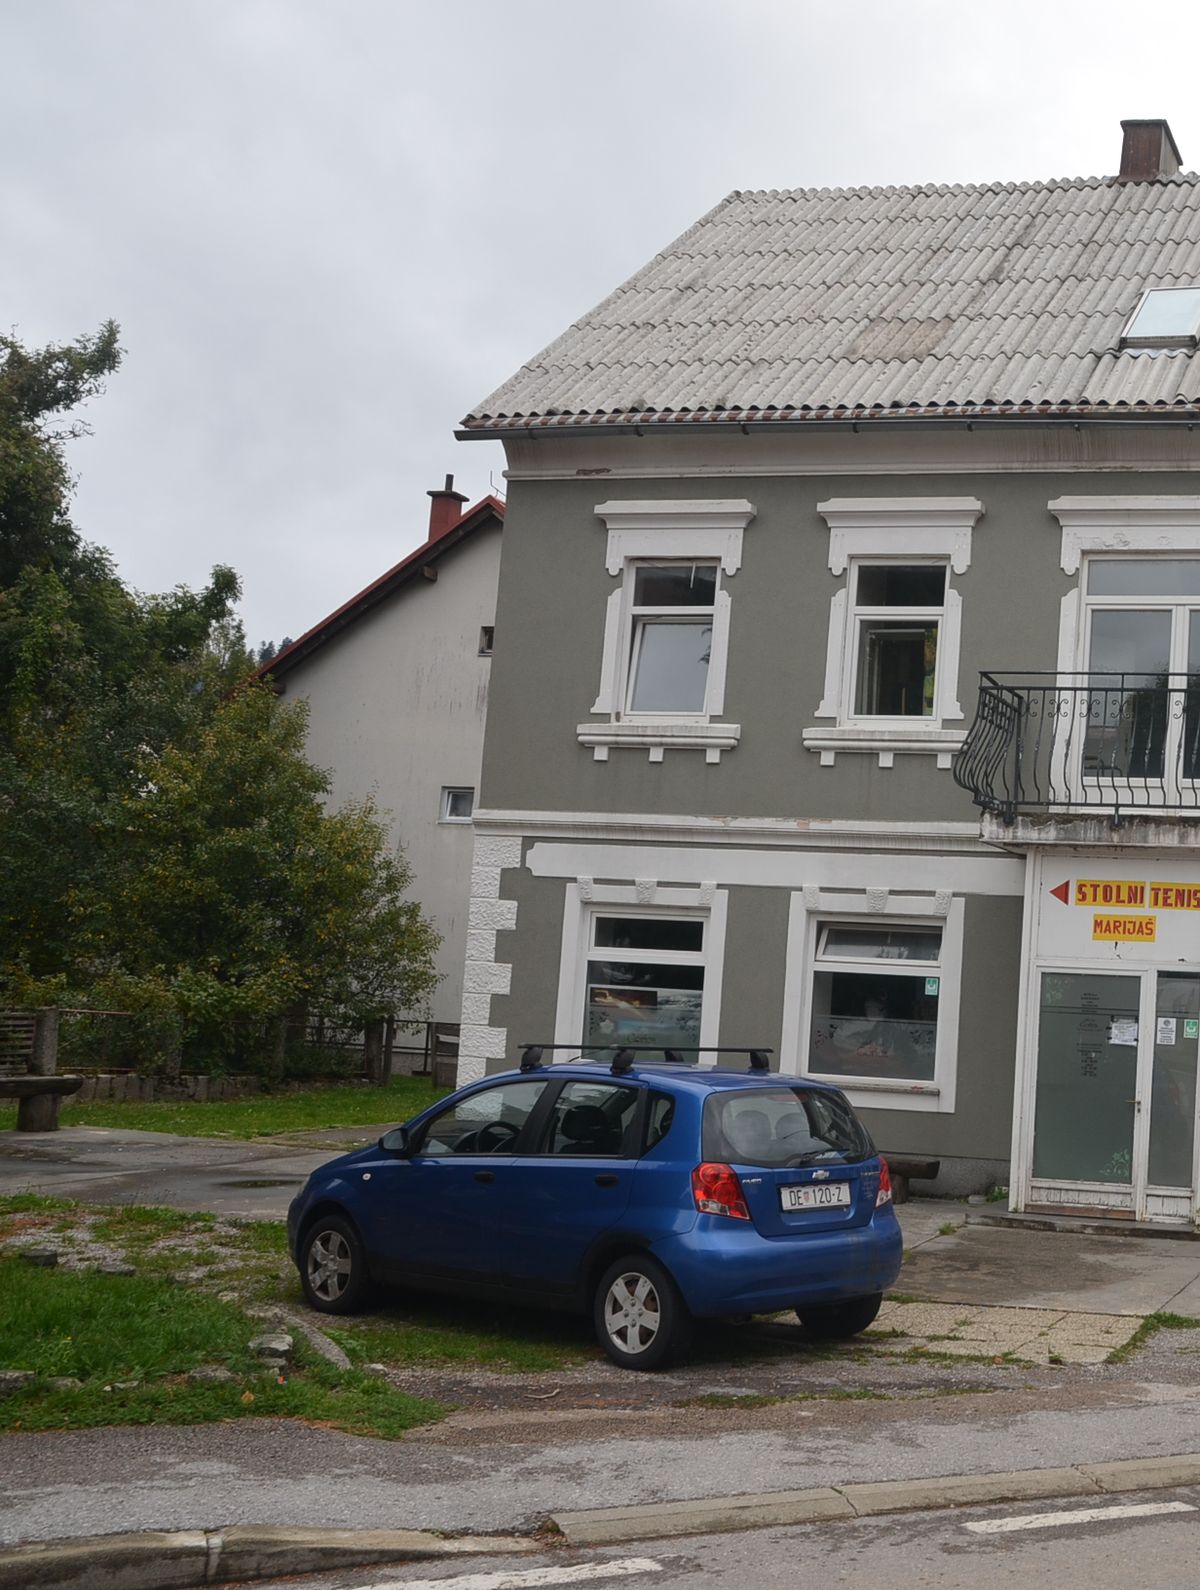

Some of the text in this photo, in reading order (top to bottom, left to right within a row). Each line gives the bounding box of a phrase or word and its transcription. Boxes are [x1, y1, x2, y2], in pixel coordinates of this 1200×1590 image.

[1076, 883, 1145, 904] STOLNI
[1093, 918, 1154, 936] MARIJAŠ
[789, 1189, 804, 1206] DE
